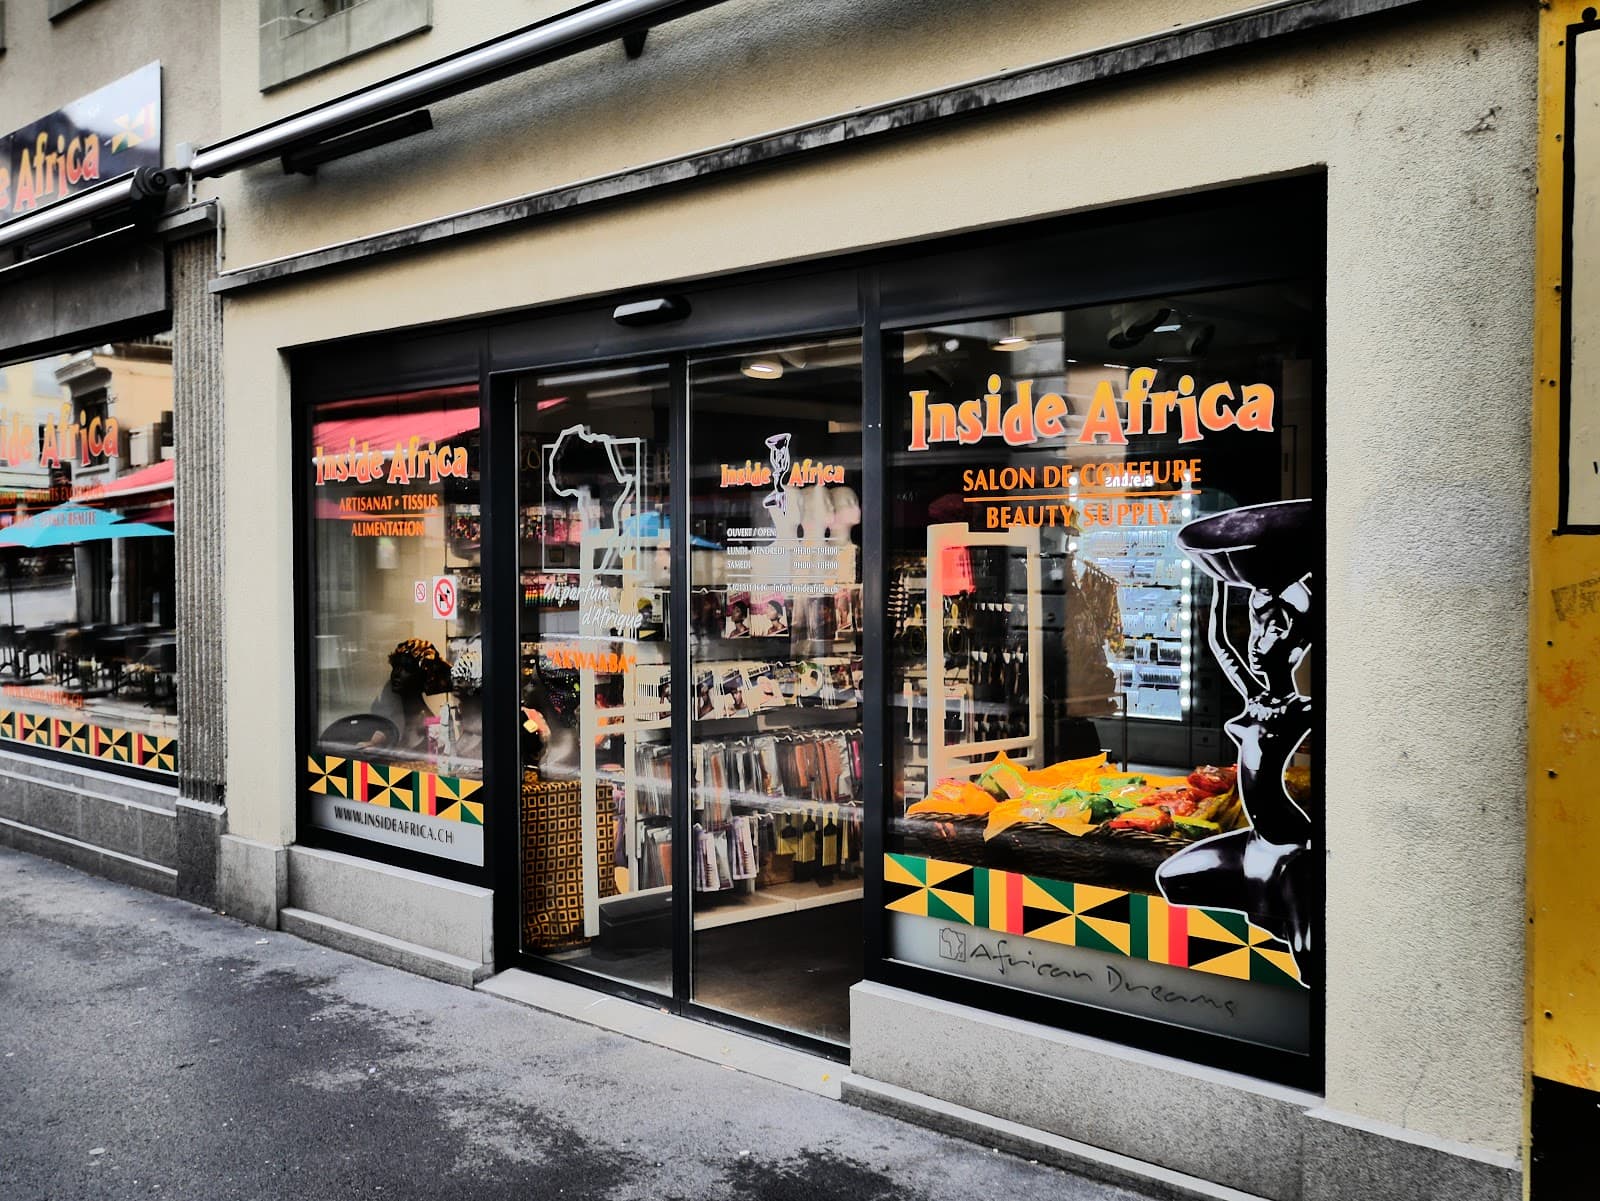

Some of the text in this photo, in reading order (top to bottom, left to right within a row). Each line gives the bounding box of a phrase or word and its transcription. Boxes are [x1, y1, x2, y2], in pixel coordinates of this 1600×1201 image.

[12, 131, 100, 213] Africa
[907, 366, 1275, 452] Inside Africa
[40, 402, 119, 468] Africa
[315, 435, 469, 486] Inside Africa
[720, 458, 845, 488] Inside Africa
[963, 458, 1202, 492] SALON DE COIFFURE
[339, 493, 440, 512] ARTISANAT TISSUS
[986, 504, 1073, 529] BEAUTY
[1083, 501, 1172, 527] SUPPLY
[351, 521, 425, 537] ALIMENTATION
[726, 528, 752, 537] OUVERT
[334, 805, 454, 844] WWW.INSIDEAFRICA.CH
[969, 940, 1238, 1017] African Dreams
